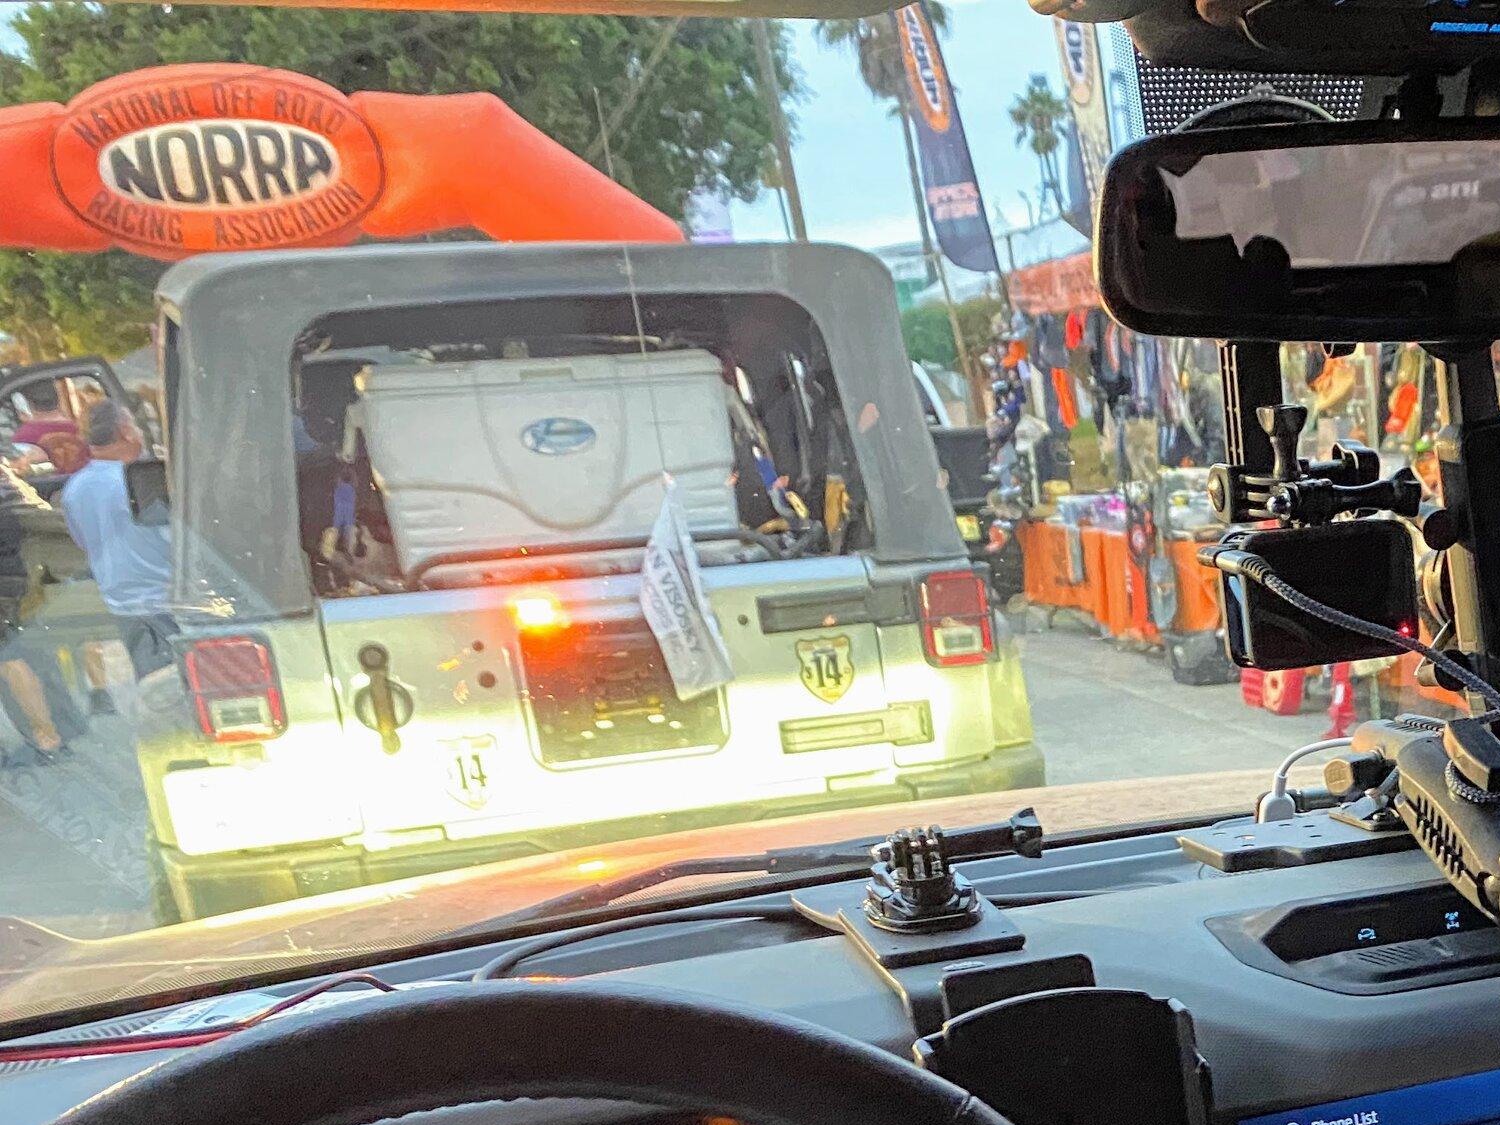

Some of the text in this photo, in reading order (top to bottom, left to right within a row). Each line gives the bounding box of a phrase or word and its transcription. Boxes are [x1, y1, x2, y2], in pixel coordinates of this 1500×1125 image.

[1430, 21, 1489, 32] PASSENGER
[69, 81, 347, 149] NATIONAL OFF ROAD
[108, 122, 333, 205] NORRA
[85, 181, 364, 247] RACING ASSOCIATION
[811, 654, 843, 687] 14
[455, 755, 487, 790] 14
